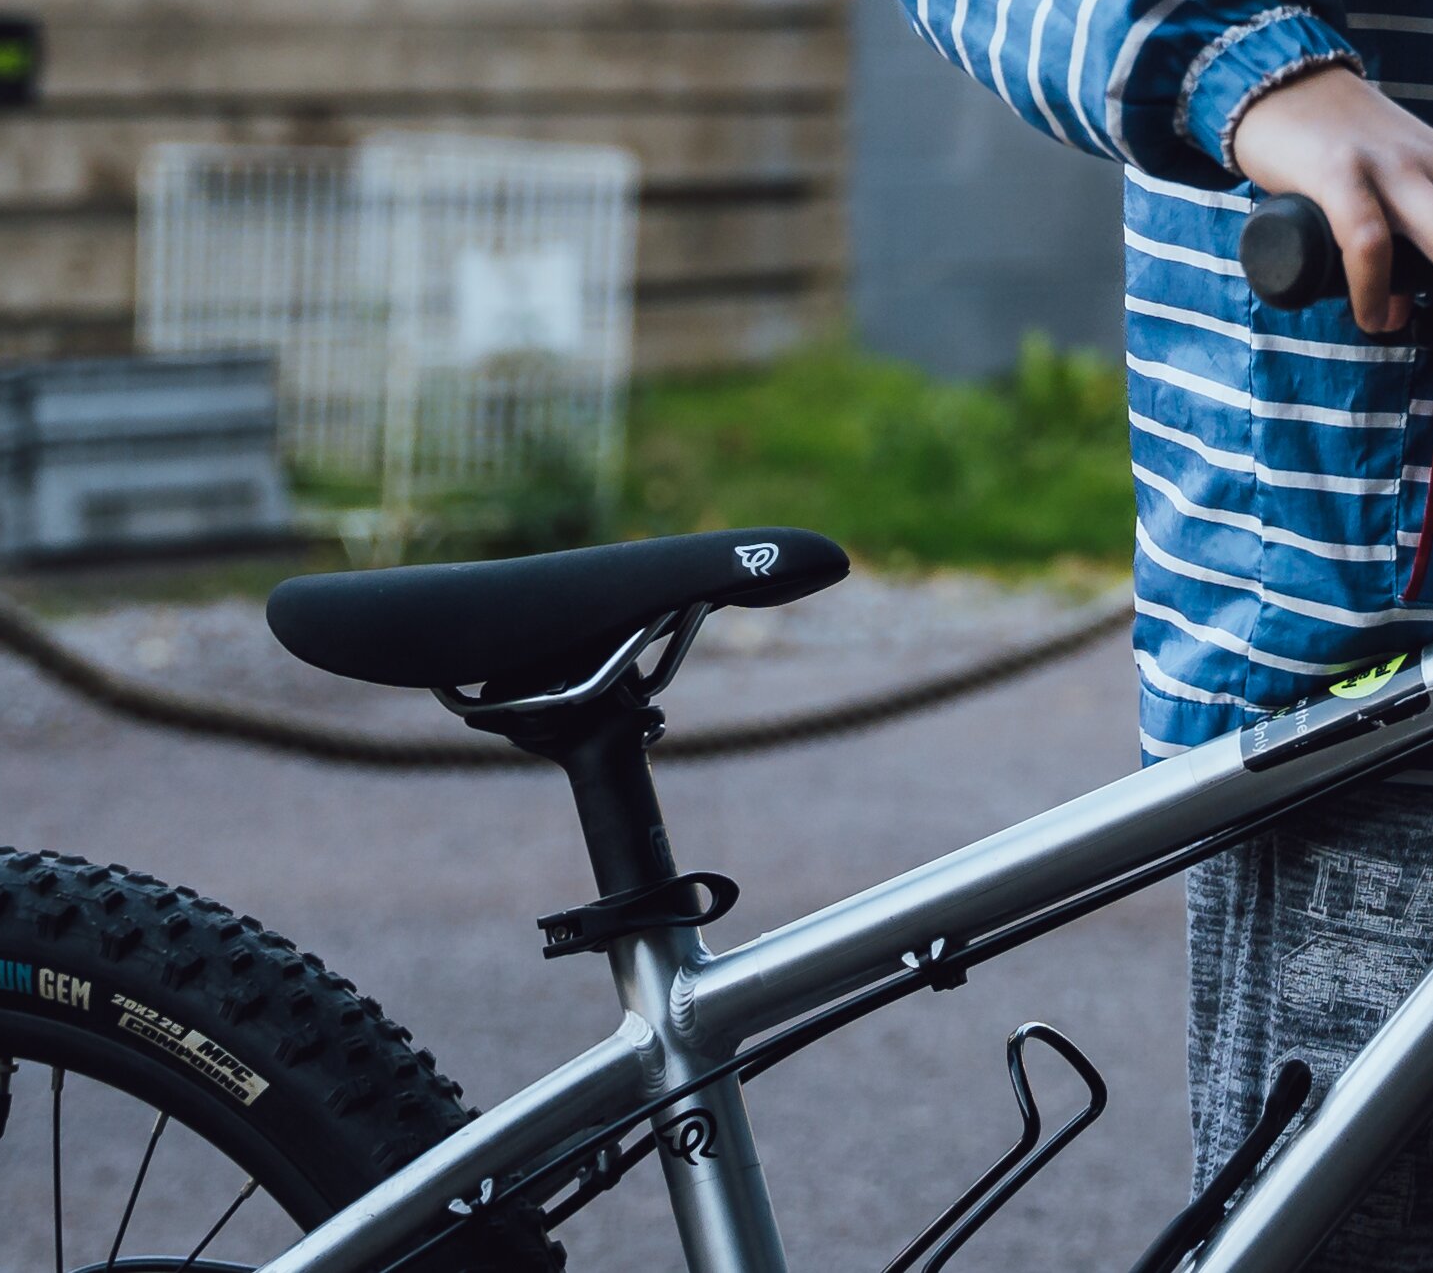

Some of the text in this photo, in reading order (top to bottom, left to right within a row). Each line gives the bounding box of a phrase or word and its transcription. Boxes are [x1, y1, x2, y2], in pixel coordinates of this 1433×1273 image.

[38, 967, 91, 1011] GEM
[125, 1017, 250, 1101] COMPOUND
[196, 1040, 253, 1083] MPC
